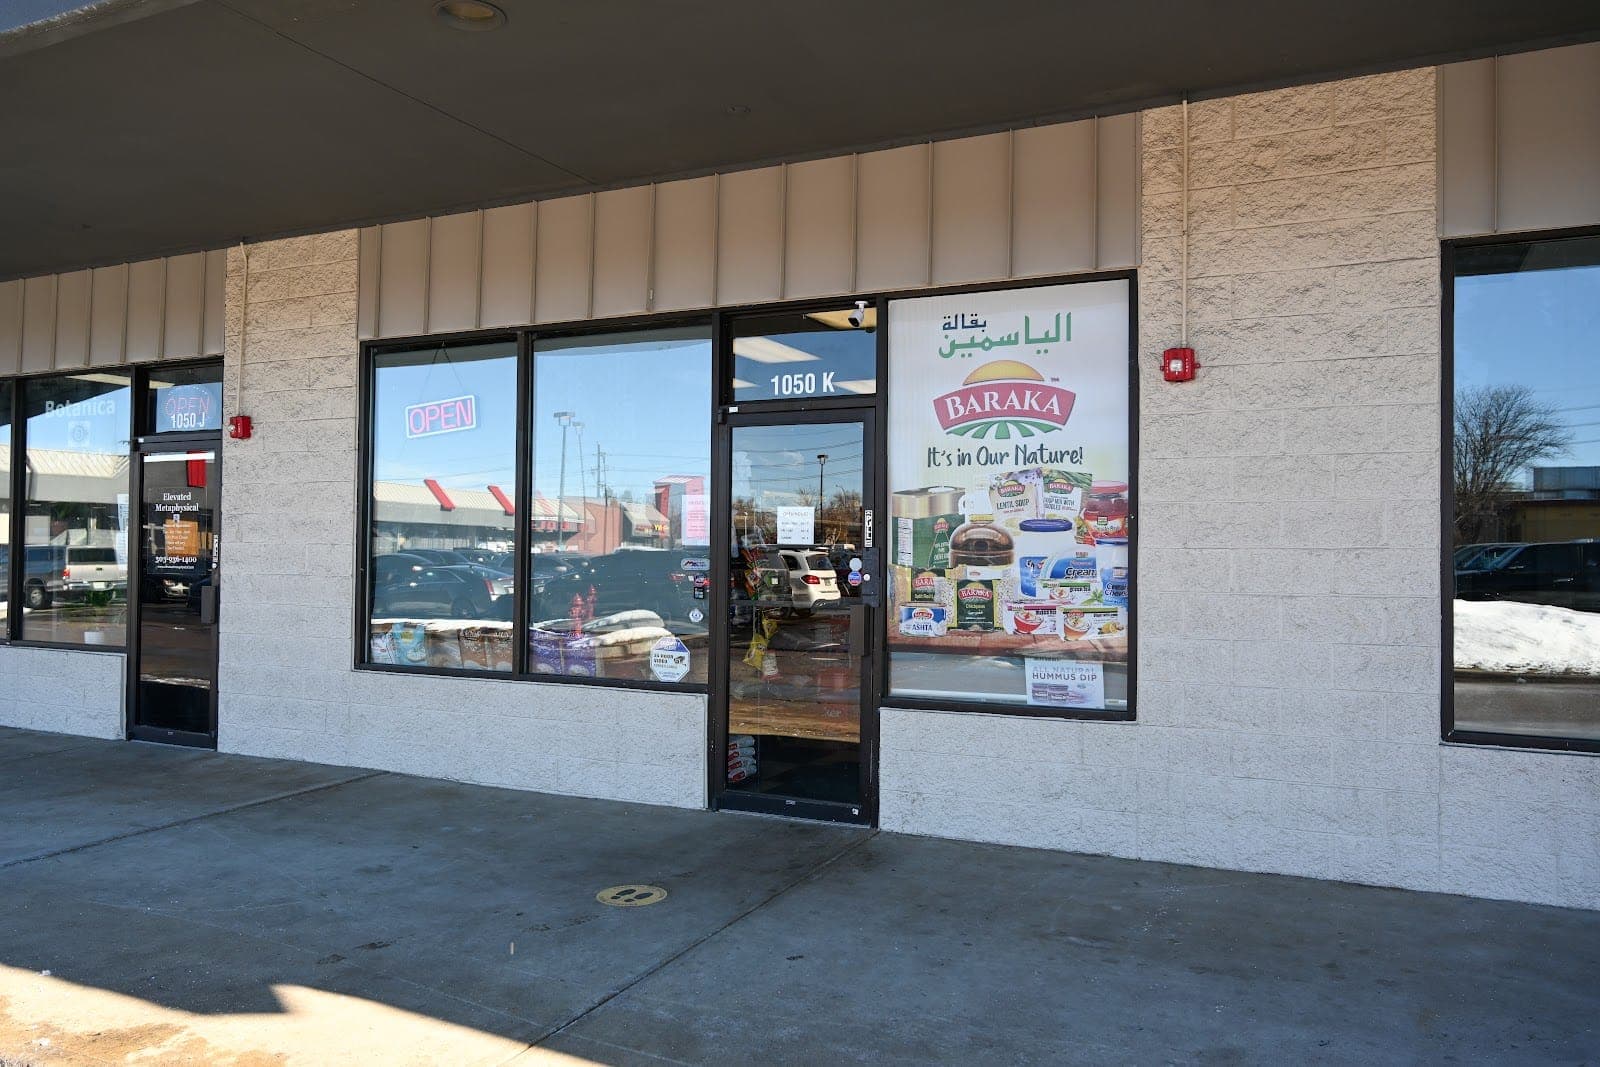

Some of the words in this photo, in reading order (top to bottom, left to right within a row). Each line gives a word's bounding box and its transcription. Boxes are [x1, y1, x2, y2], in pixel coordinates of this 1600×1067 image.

[942, 312, 987, 333] بقالة
[938, 311, 1072, 359] الياسمين
[770, 372, 816, 396] 1050
[822, 371, 835, 393] K
[45, 398, 116, 418] Botanica
[166, 396, 210, 416] OPEN
[943, 389, 1062, 421] BARAKA
[171, 412, 196, 429] 1050
[197, 412, 206, 428] J
[409, 399, 473, 434] OPEN
[927, 446, 952, 468] It's
[957, 447, 972, 466] in
[976, 445, 1010, 467] Our
[1014, 443, 1084, 466] Nature!
[163, 491, 192, 501] Elevated
[155, 503, 199, 513] Metaphysical
[915, 577, 934, 587] BARA
[912, 623, 933, 632] ASHTA
[1032, 672, 1076, 681] HUMMUS
[1080, 674, 1097, 682] DIP
